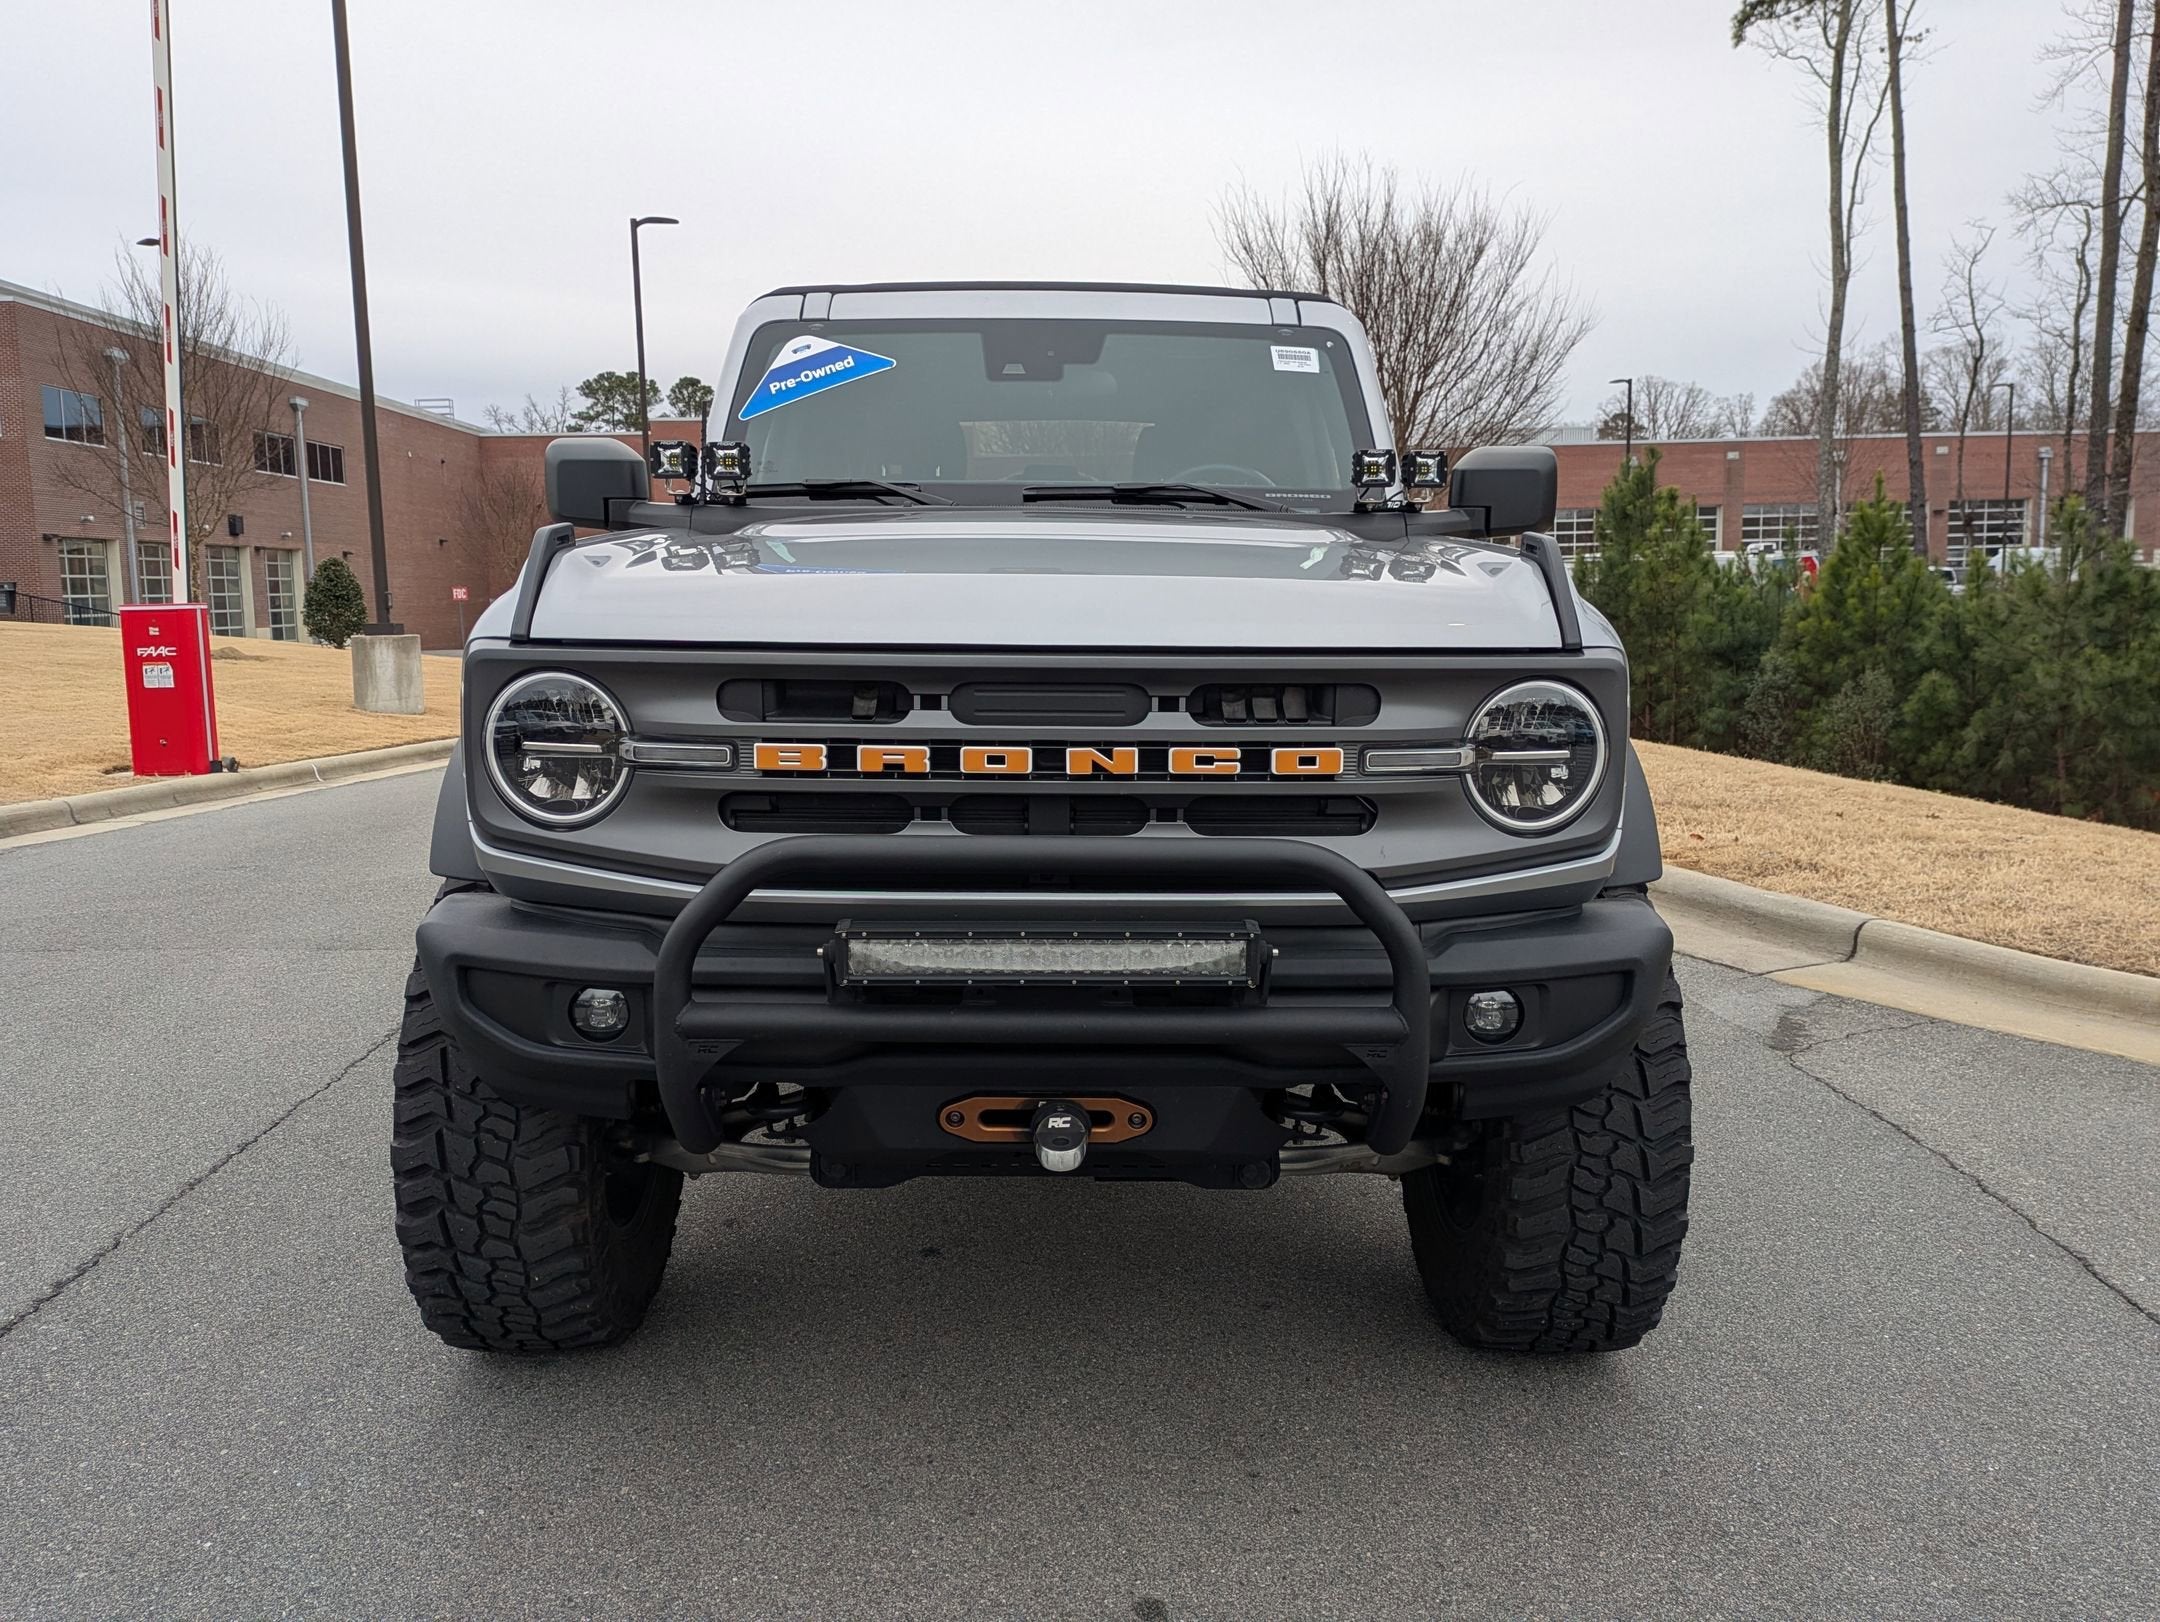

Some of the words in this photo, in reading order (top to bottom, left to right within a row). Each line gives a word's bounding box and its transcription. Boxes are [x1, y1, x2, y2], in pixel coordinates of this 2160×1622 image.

[769, 355, 855, 395] Pre-Owned
[453, 588, 467, 599] FDC
[136, 646, 177, 657] FAAC
[753, 743, 1344, 775] BRONCO
[1047, 1116, 1072, 1129] RC
